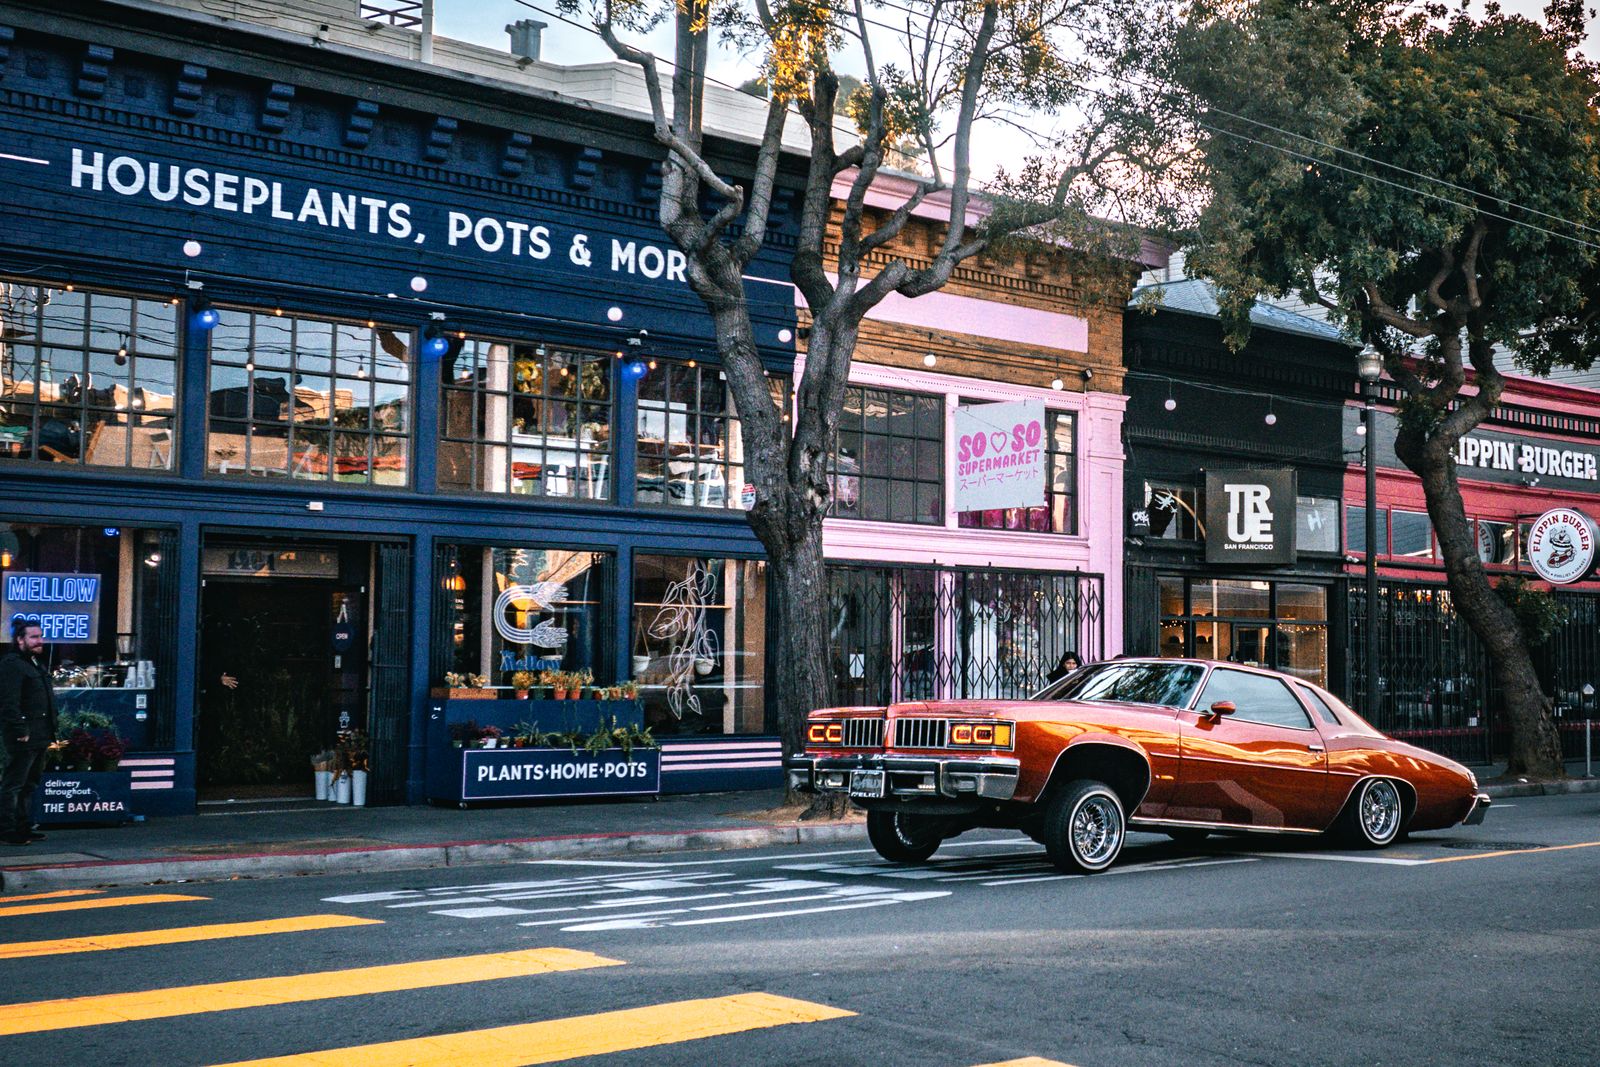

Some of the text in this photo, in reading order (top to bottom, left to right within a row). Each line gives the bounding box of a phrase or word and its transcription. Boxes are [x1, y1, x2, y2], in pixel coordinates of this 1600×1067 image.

[71, 147, 687, 283] HOUSEPLANTS, POTS & MOR
[957, 420, 1041, 462] SO SO
[958, 448, 1040, 476] SUPERMARKET
[1449, 436, 1597, 481] IPPIN BURGER
[960, 466, 1038, 492] スーパーマーケット
[1532, 514, 1590, 553] FLIPPIN BURGER
[8, 576, 97, 603] MELLOW
[13, 612, 90, 639] FFEE
[44, 779, 81, 789] delivery
[477, 762, 647, 782] PLANTS HOME POTS
[44, 787, 92, 799] throughout
[43, 801, 124, 813] THE BAY AREA
